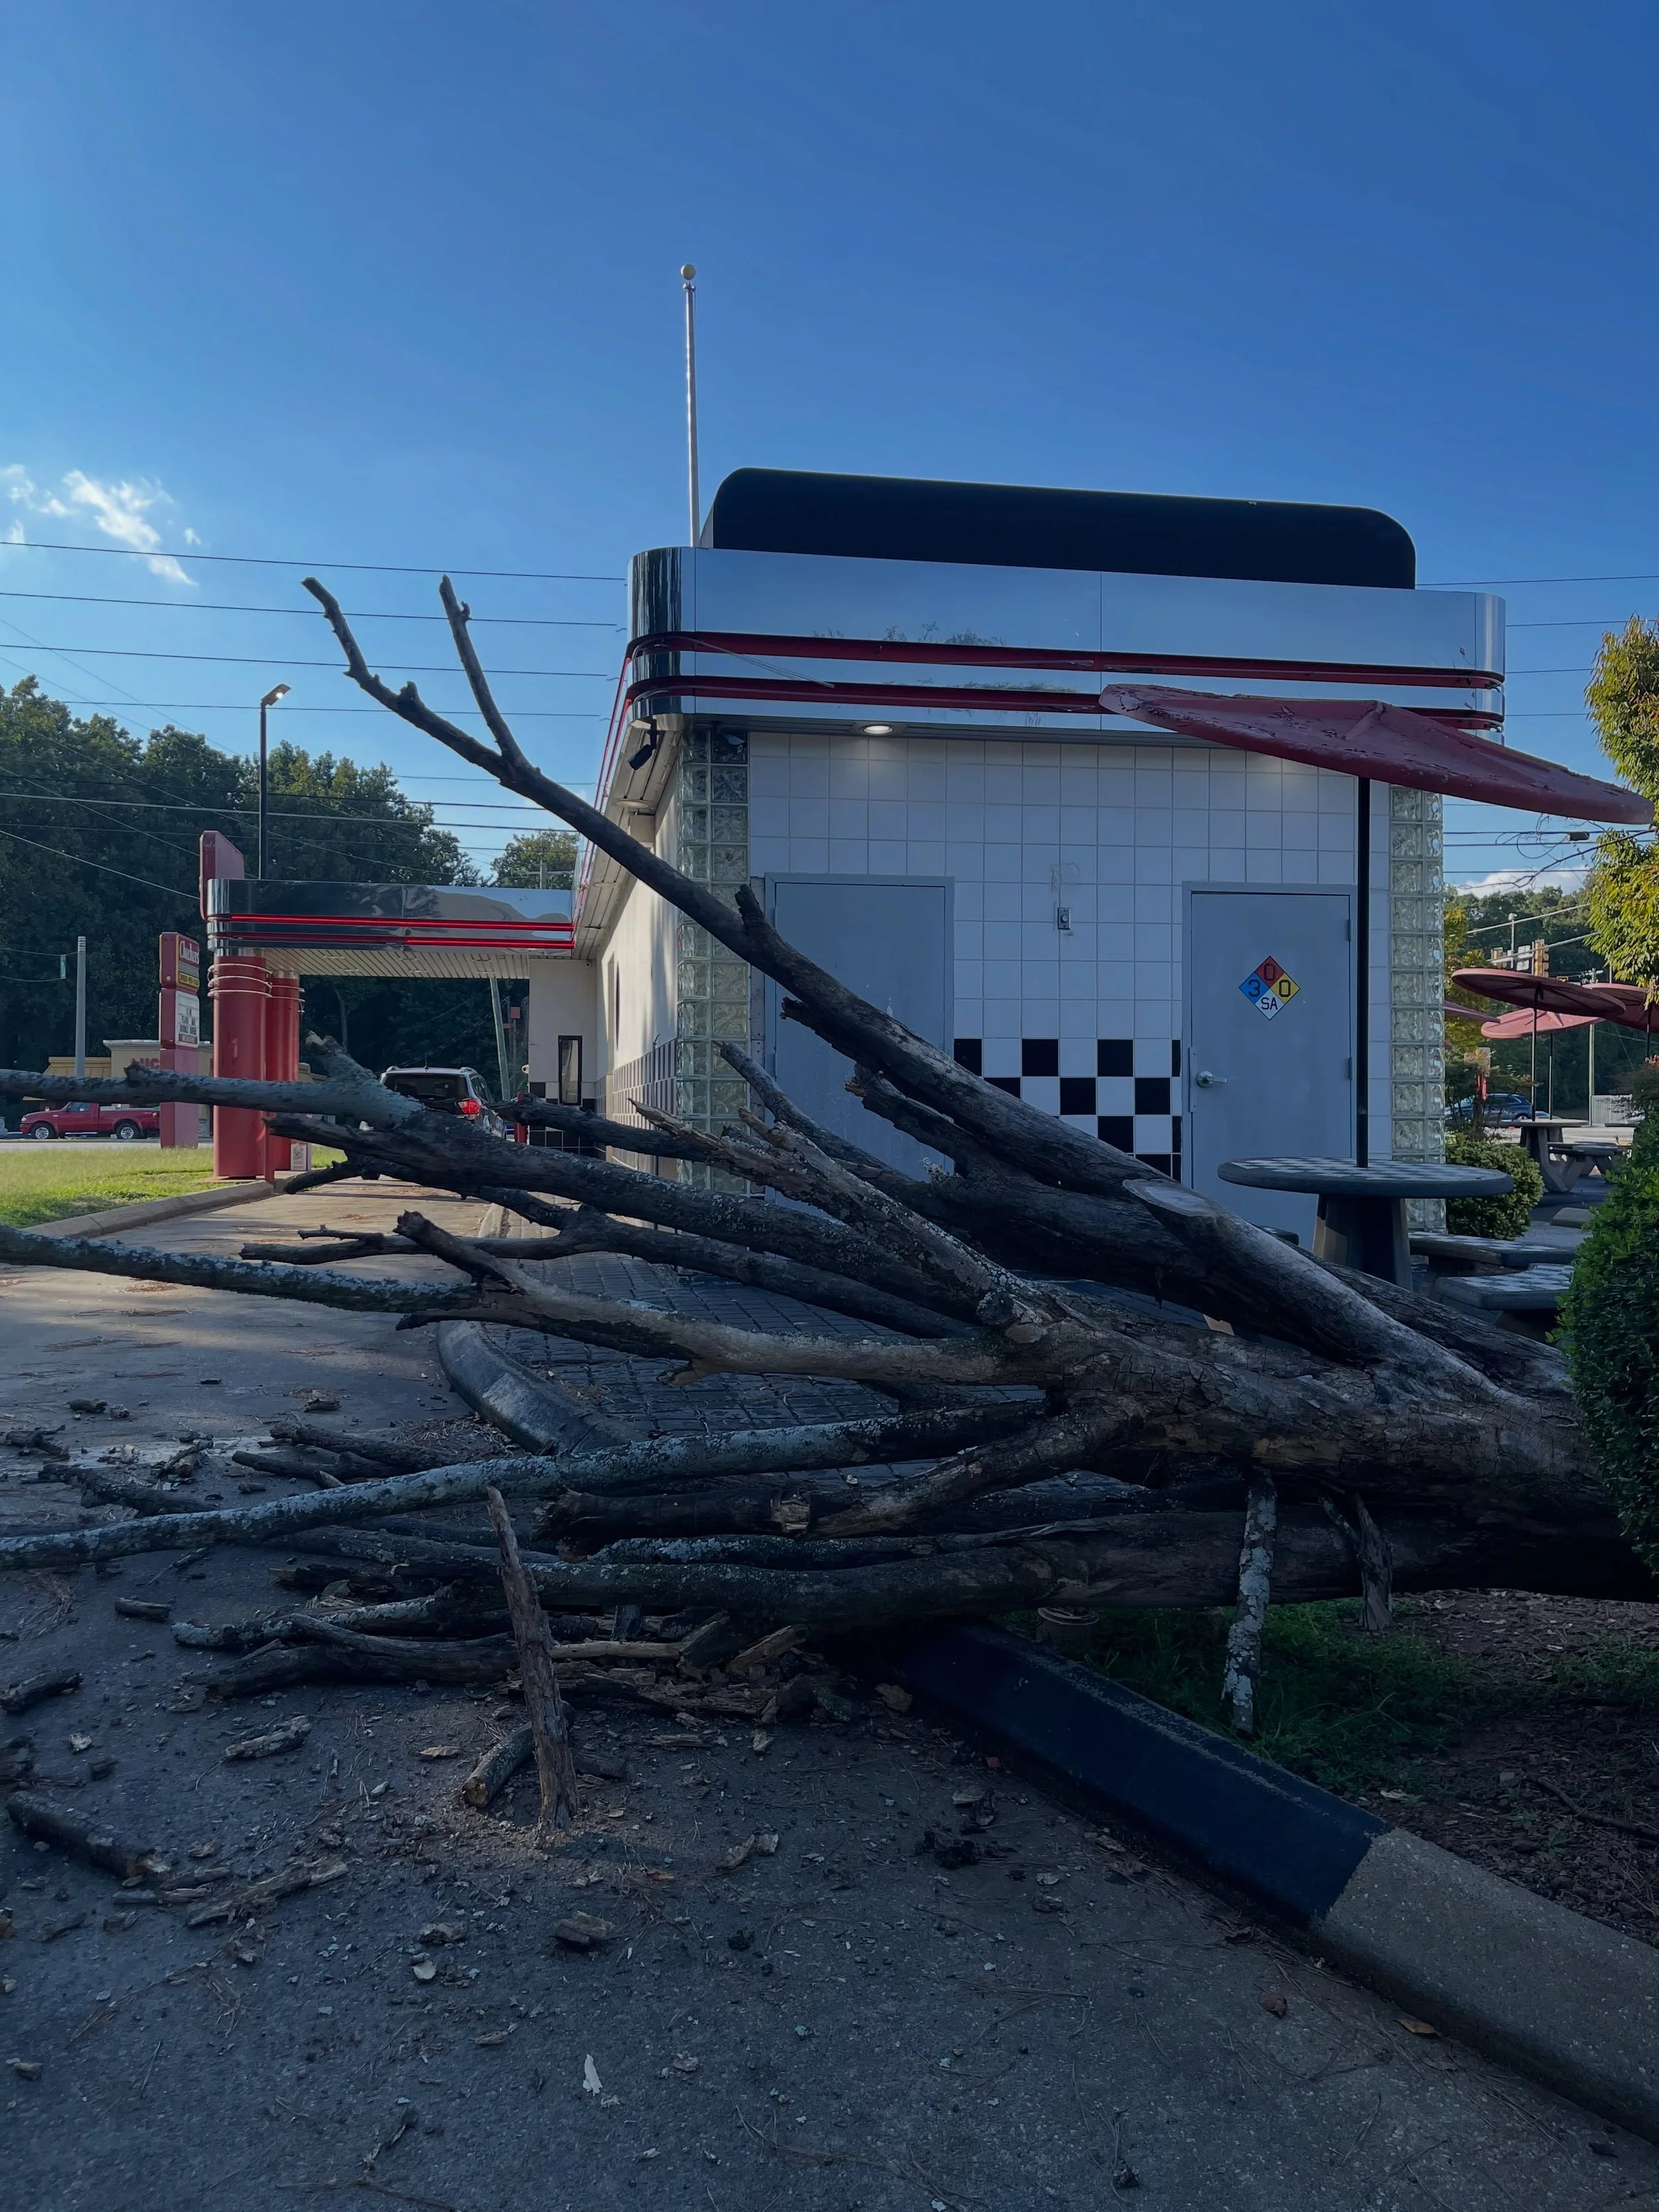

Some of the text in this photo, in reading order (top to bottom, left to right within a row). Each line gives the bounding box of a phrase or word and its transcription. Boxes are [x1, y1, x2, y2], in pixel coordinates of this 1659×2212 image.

[1263, 963, 1276, 981] 0
[1248, 979, 1261, 997] 3
[1279, 979, 1291, 997] 0
[1261, 997, 1278, 1010] SA
